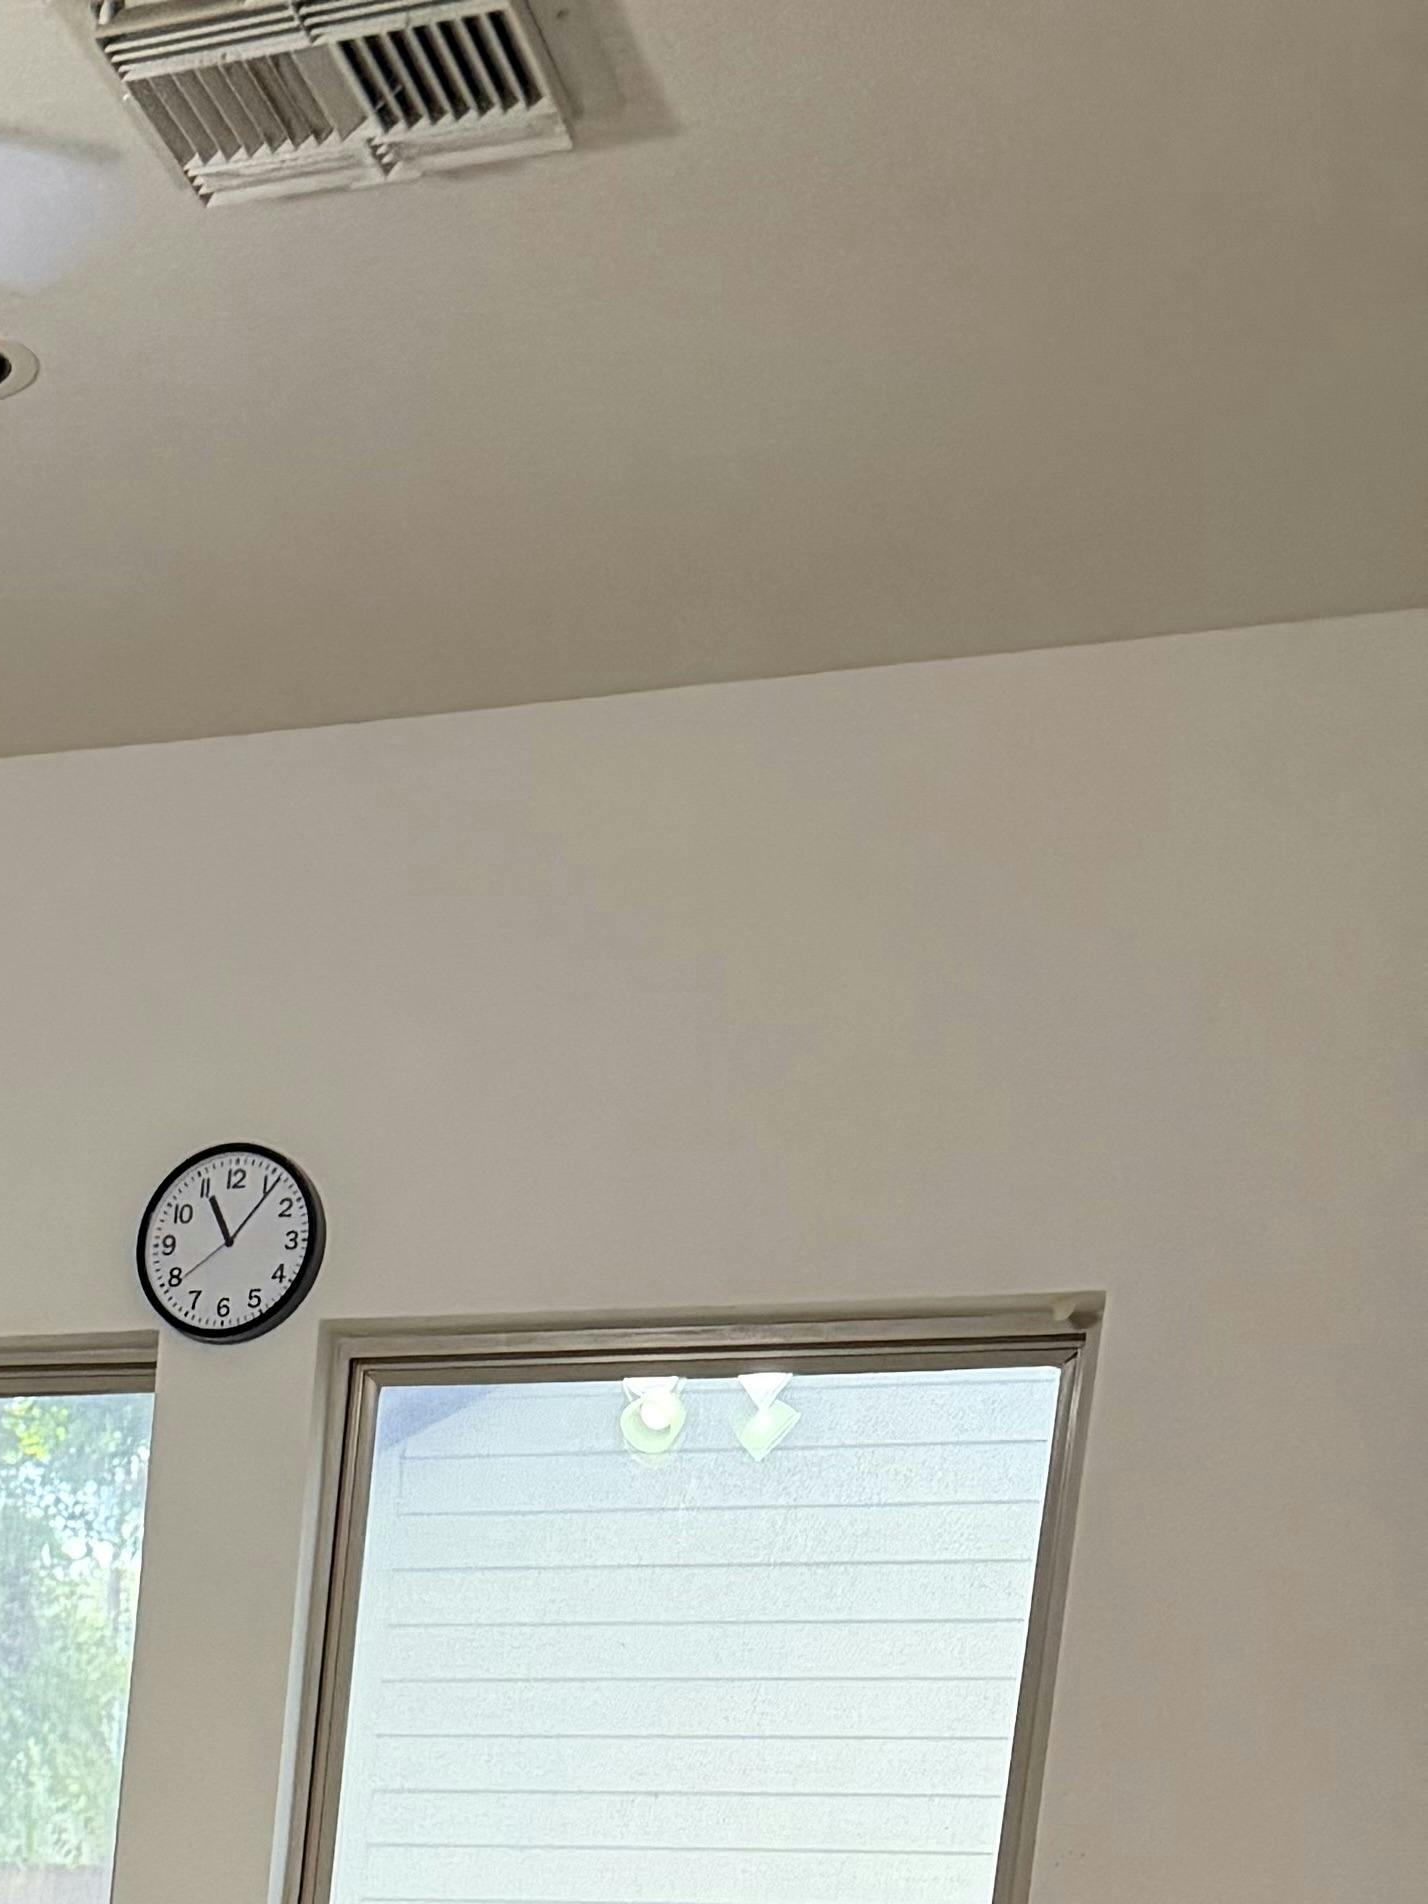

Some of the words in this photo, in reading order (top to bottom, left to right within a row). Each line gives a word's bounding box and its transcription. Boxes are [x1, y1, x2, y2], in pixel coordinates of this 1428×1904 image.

[200, 1177, 211, 1198] 11
[226, 1168, 247, 1190] 12
[173, 1203, 194, 1224] 10
[277, 1197, 294, 1218] 2
[161, 1234, 177, 1256] 9
[283, 1230, 299, 1250] 3
[168, 1267, 182, 1287] 8
[271, 1263, 286, 1284] 4
[188, 1290, 203, 1310] 7
[216, 1297, 230, 1318] 6
[247, 1288, 262, 1309] 5
